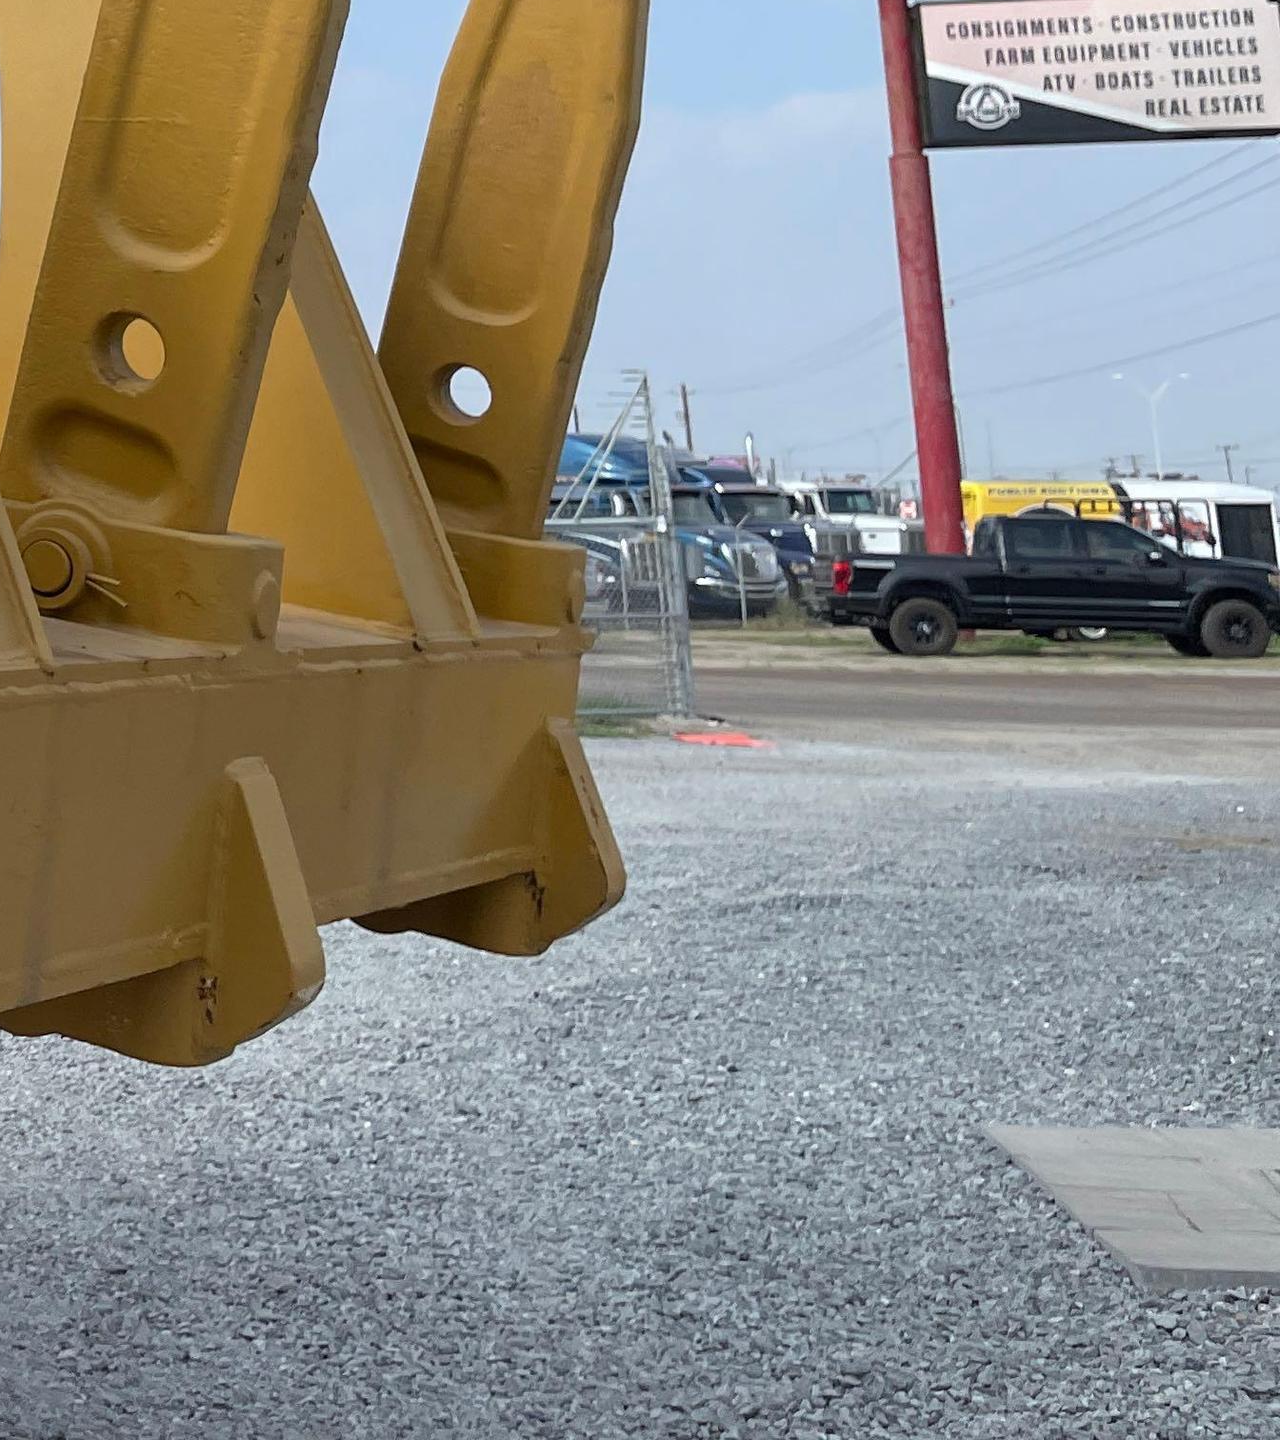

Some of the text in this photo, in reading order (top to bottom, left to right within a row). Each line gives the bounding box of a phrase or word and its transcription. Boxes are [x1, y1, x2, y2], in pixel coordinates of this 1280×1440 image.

[945, 7, 1255, 40] CONSIGNMENTS CONSTRUCTION
[984, 36, 1259, 67] FARM EQUIPMENT VEHICLES
[1042, 64, 1262, 92] ATV BOATS TRAILERS
[1144, 93, 1266, 118] REAL ESTATE
